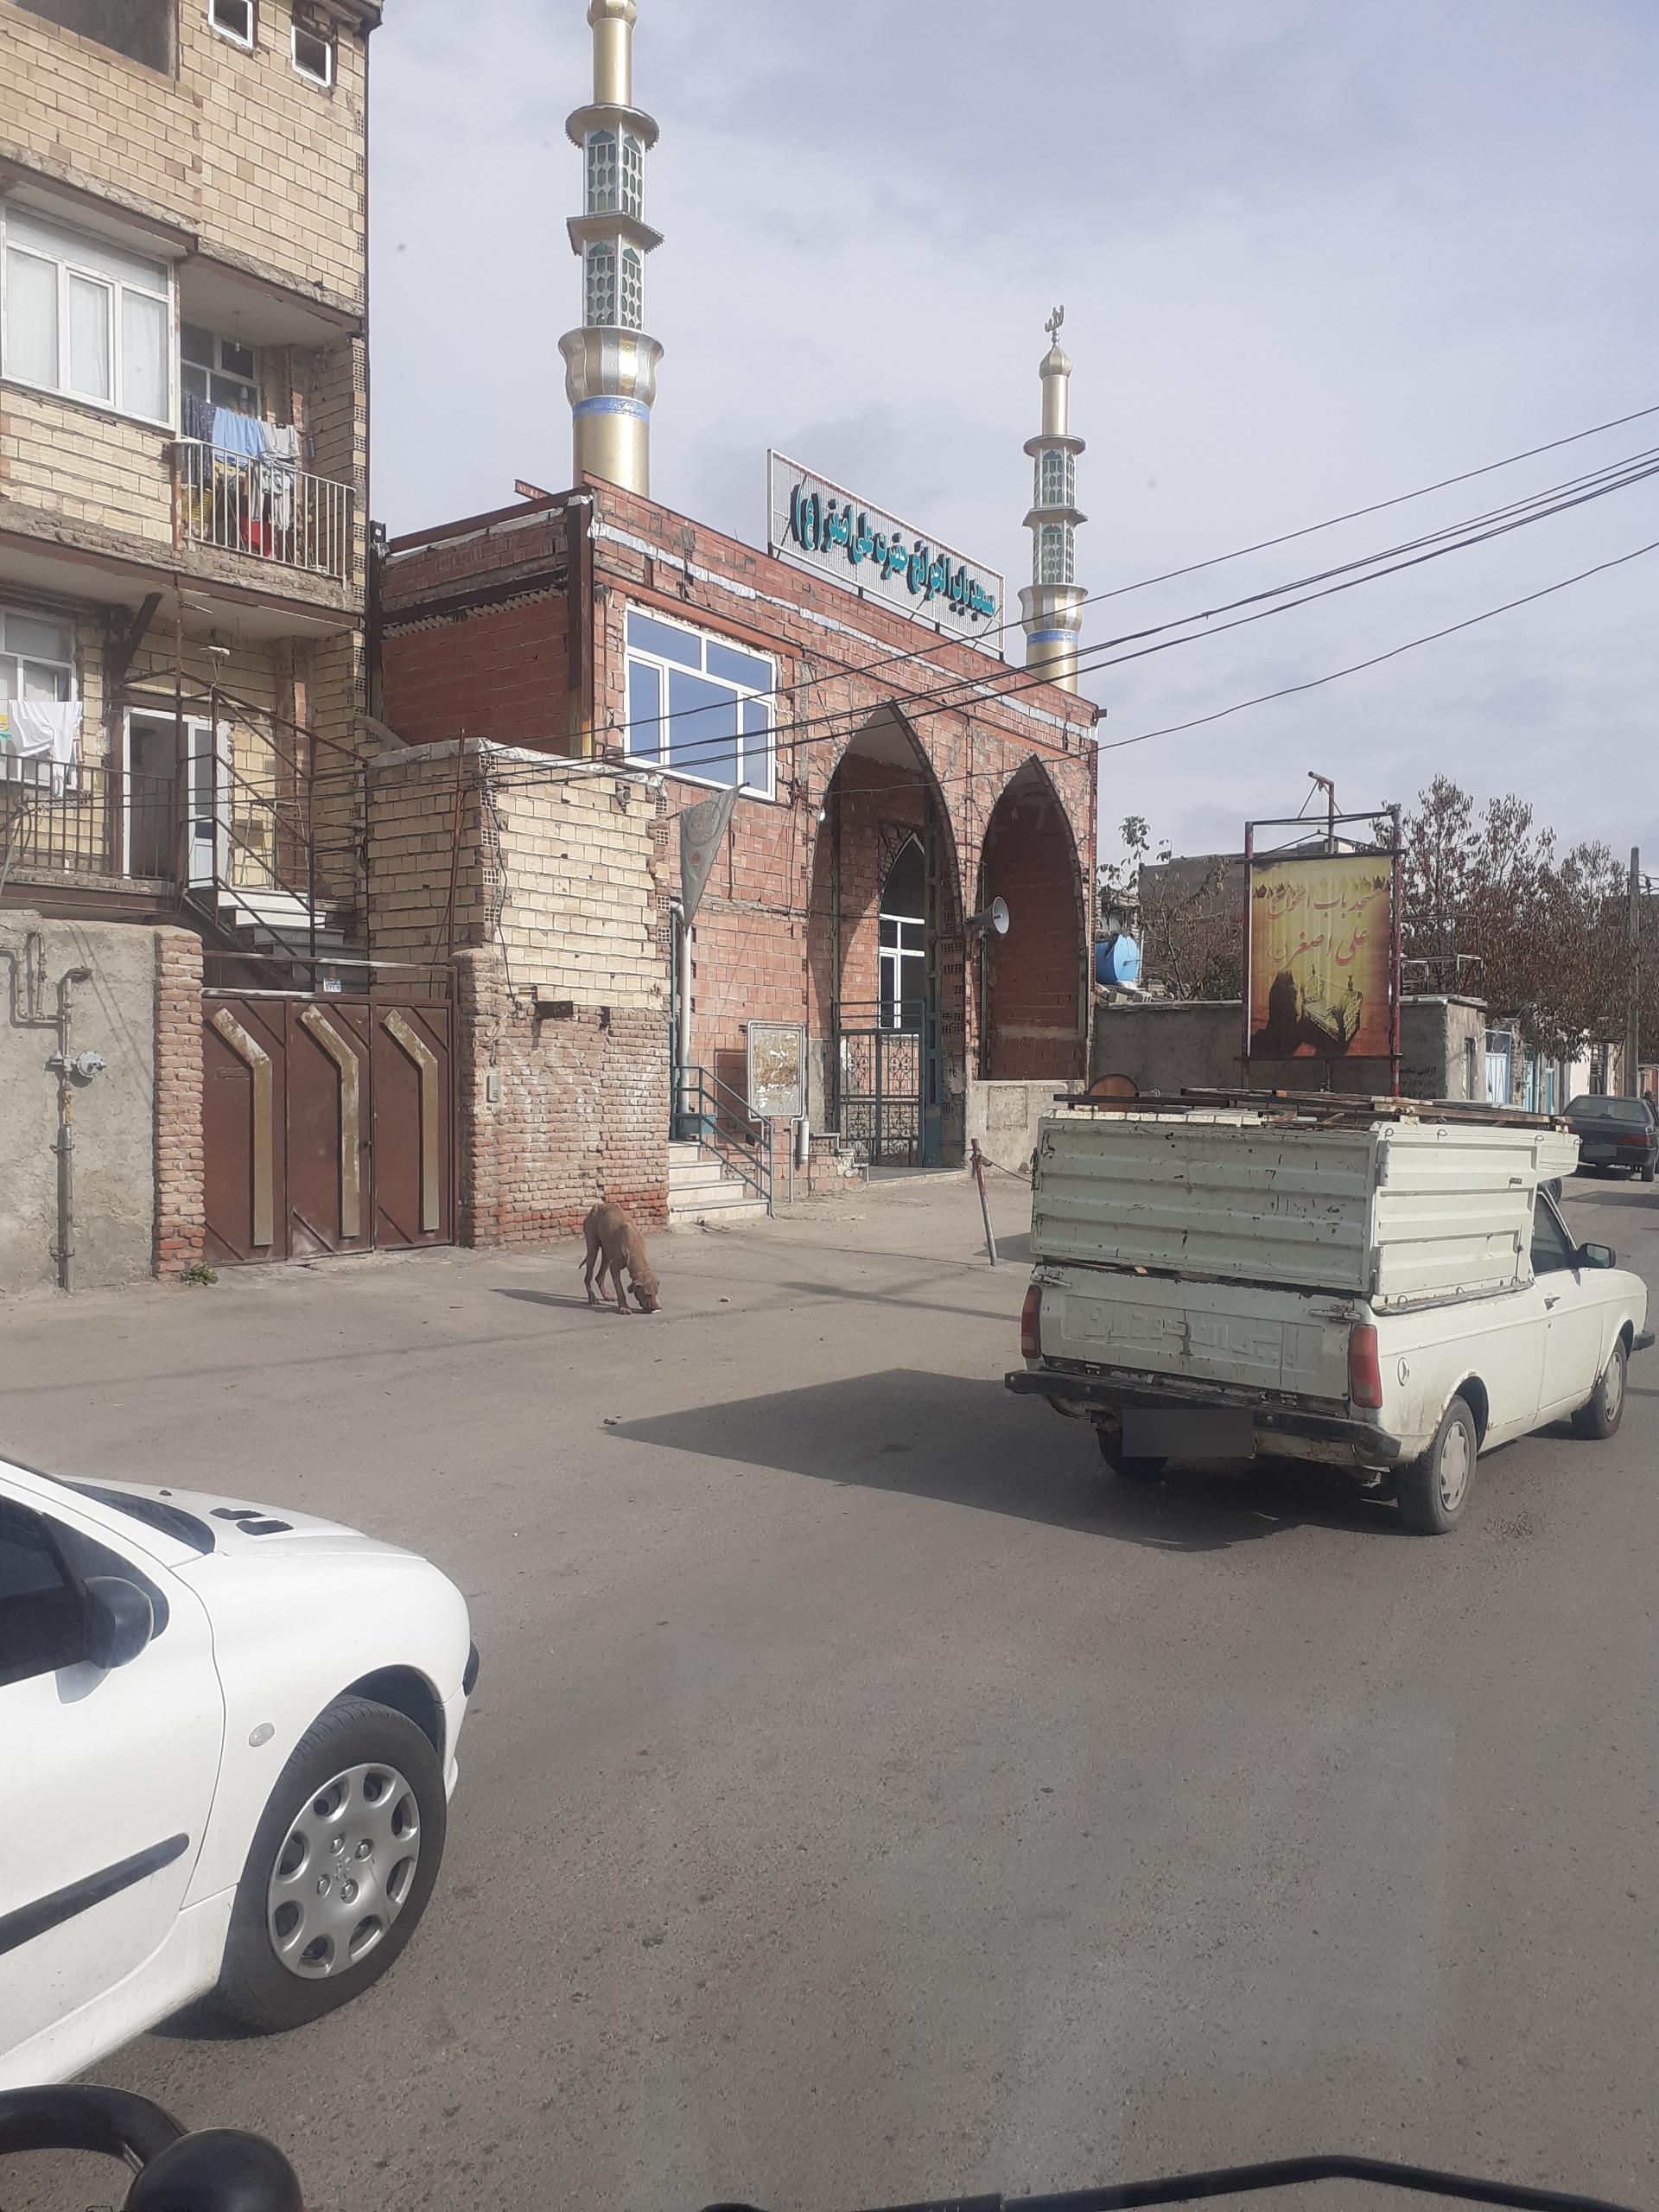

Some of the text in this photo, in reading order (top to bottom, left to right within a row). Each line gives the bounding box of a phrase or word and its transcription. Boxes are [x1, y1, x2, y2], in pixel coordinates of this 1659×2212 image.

[822, 498, 854, 554] اصغر
[847, 512, 874, 565] علی
[871, 532, 909, 581] حضرت
[949, 564, 969, 616] باب
[968, 578, 996, 622] مسجد
[1313, 892, 1347, 919] باب
[1348, 887, 1382, 919] مسجد
[1284, 931, 1333, 971] اصغر
[1334, 925, 1370, 967] علی
[1084, 1303, 1300, 1367] ایران خودرو
